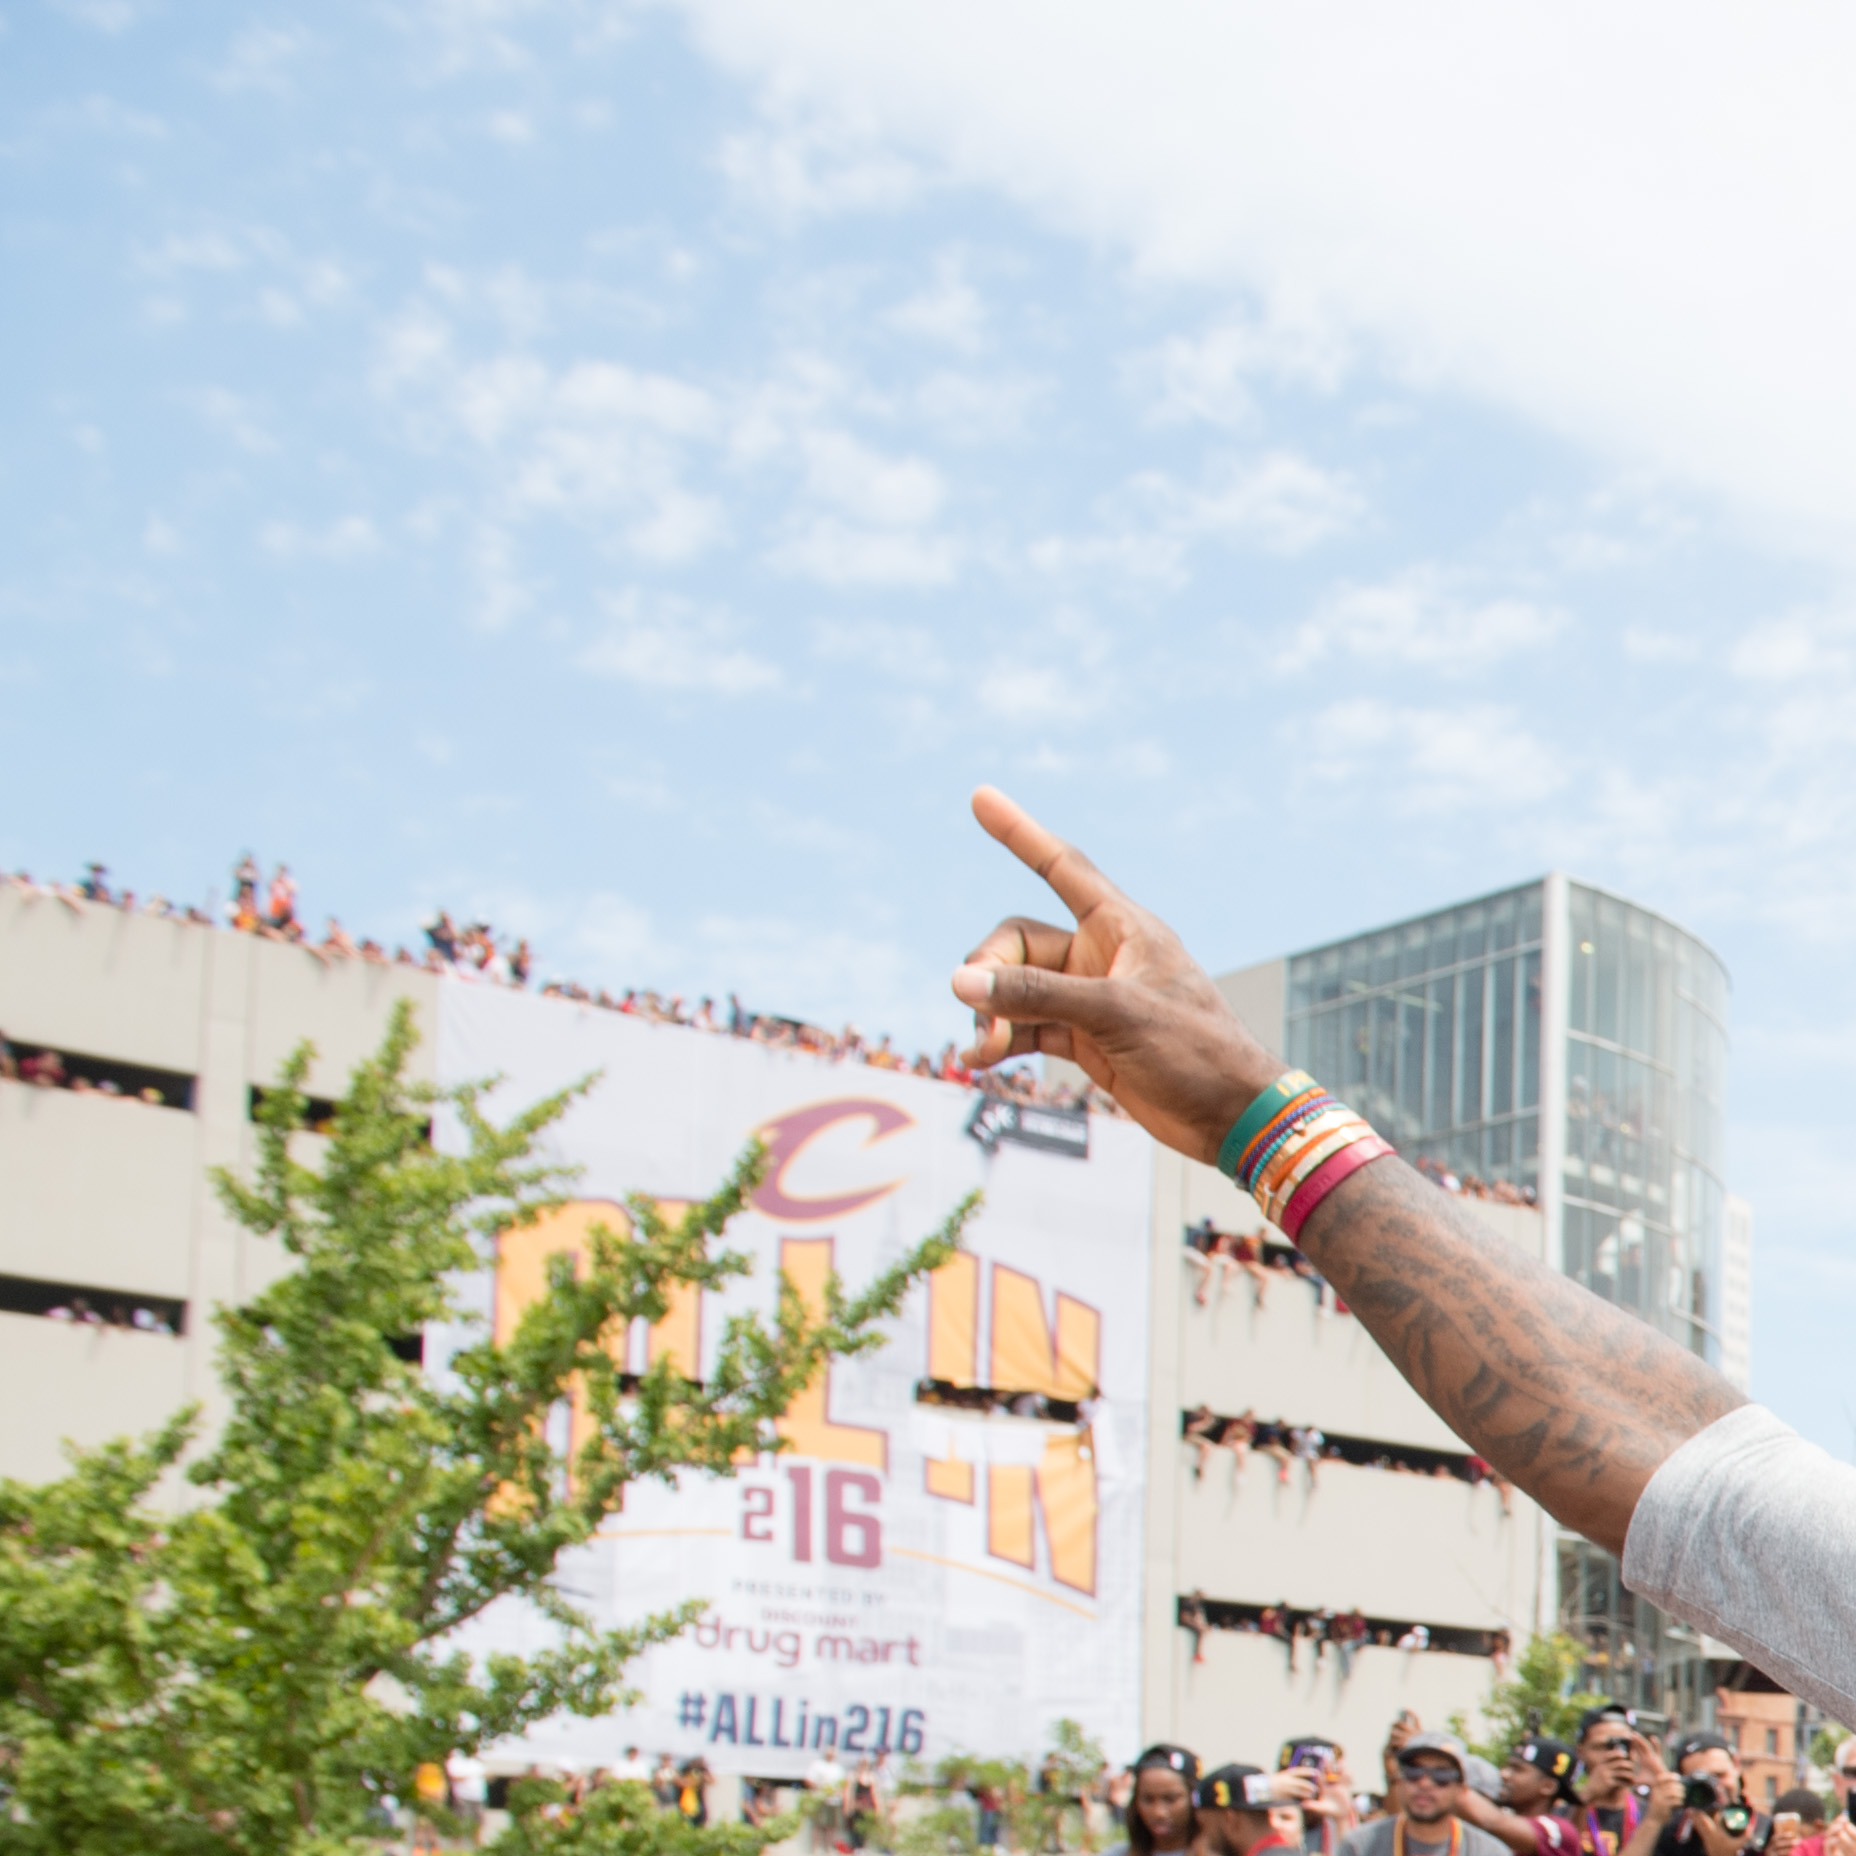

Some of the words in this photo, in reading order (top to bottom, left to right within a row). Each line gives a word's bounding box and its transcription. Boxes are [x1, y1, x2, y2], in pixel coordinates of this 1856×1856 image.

[740, 1465, 882, 1569] 216
[696, 1616, 801, 1668] drug
[815, 1634, 919, 1667] mart
[677, 1690, 926, 1755] #ALLin216
